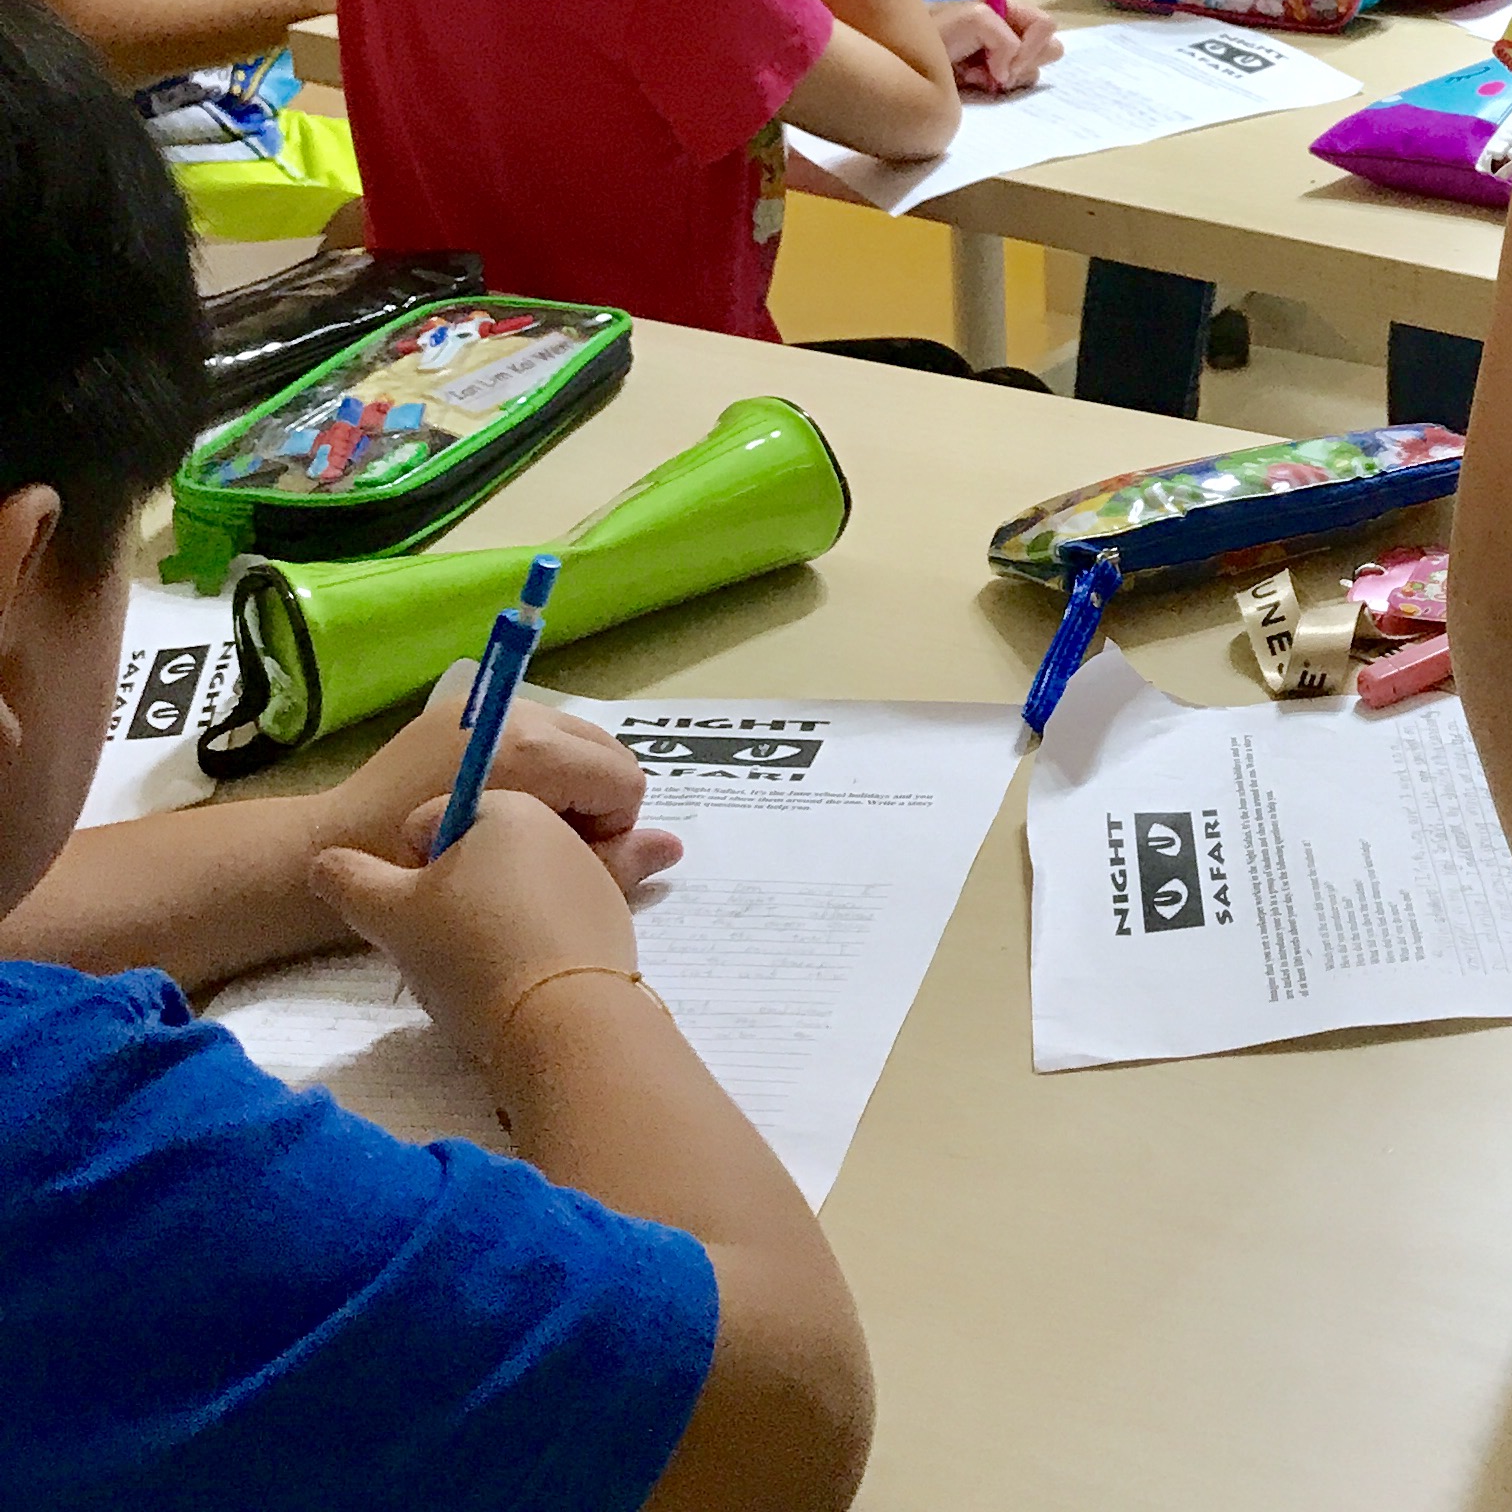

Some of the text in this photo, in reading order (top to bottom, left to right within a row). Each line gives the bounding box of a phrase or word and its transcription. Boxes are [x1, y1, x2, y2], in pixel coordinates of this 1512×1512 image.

[620, 717, 831, 732] NIGHT
[640, 767, 806, 782] FARI
[1105, 812, 1133, 937] NIGHT
[1201, 808, 1235, 926] SAFARI
